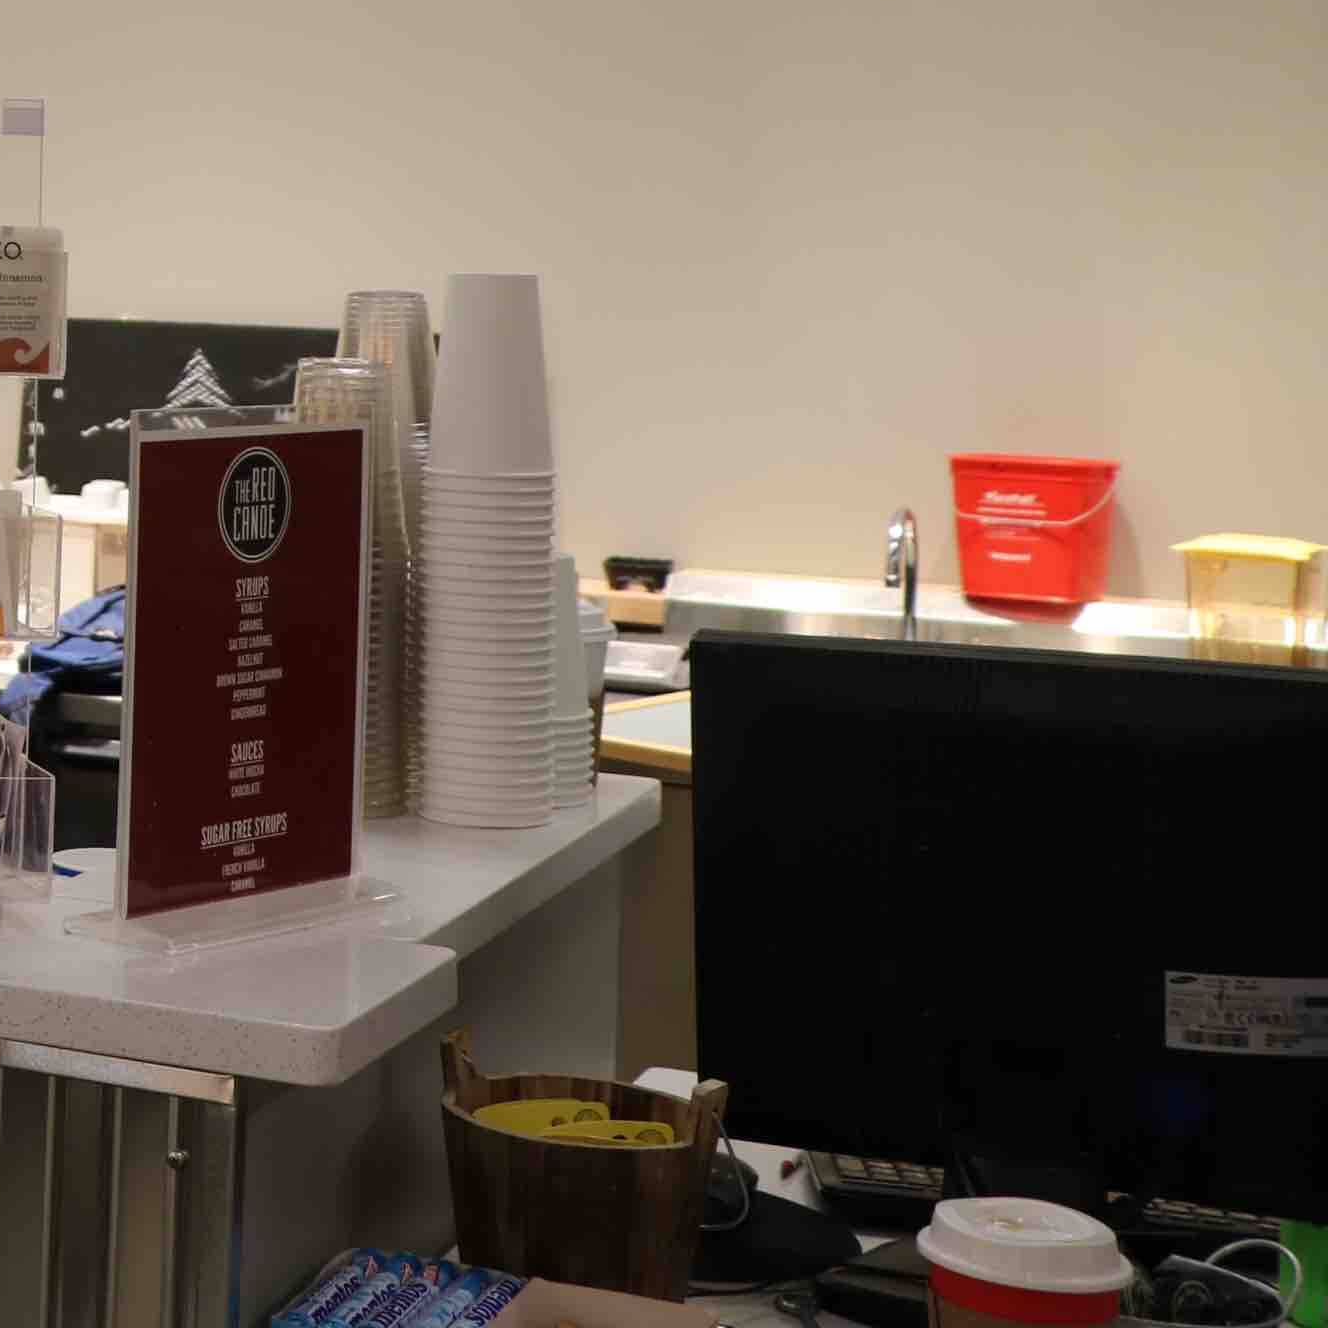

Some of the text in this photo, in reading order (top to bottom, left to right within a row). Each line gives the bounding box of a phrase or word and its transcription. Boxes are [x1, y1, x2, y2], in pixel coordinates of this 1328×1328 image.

[234, 466, 276, 505] THE RED
[233, 503, 276, 543] CANOE
[235, 575, 270, 599] SYRUPS
[231, 739, 265, 764] SAUCES
[200, 811, 288, 847] SUGAR FREE SYRUPS
